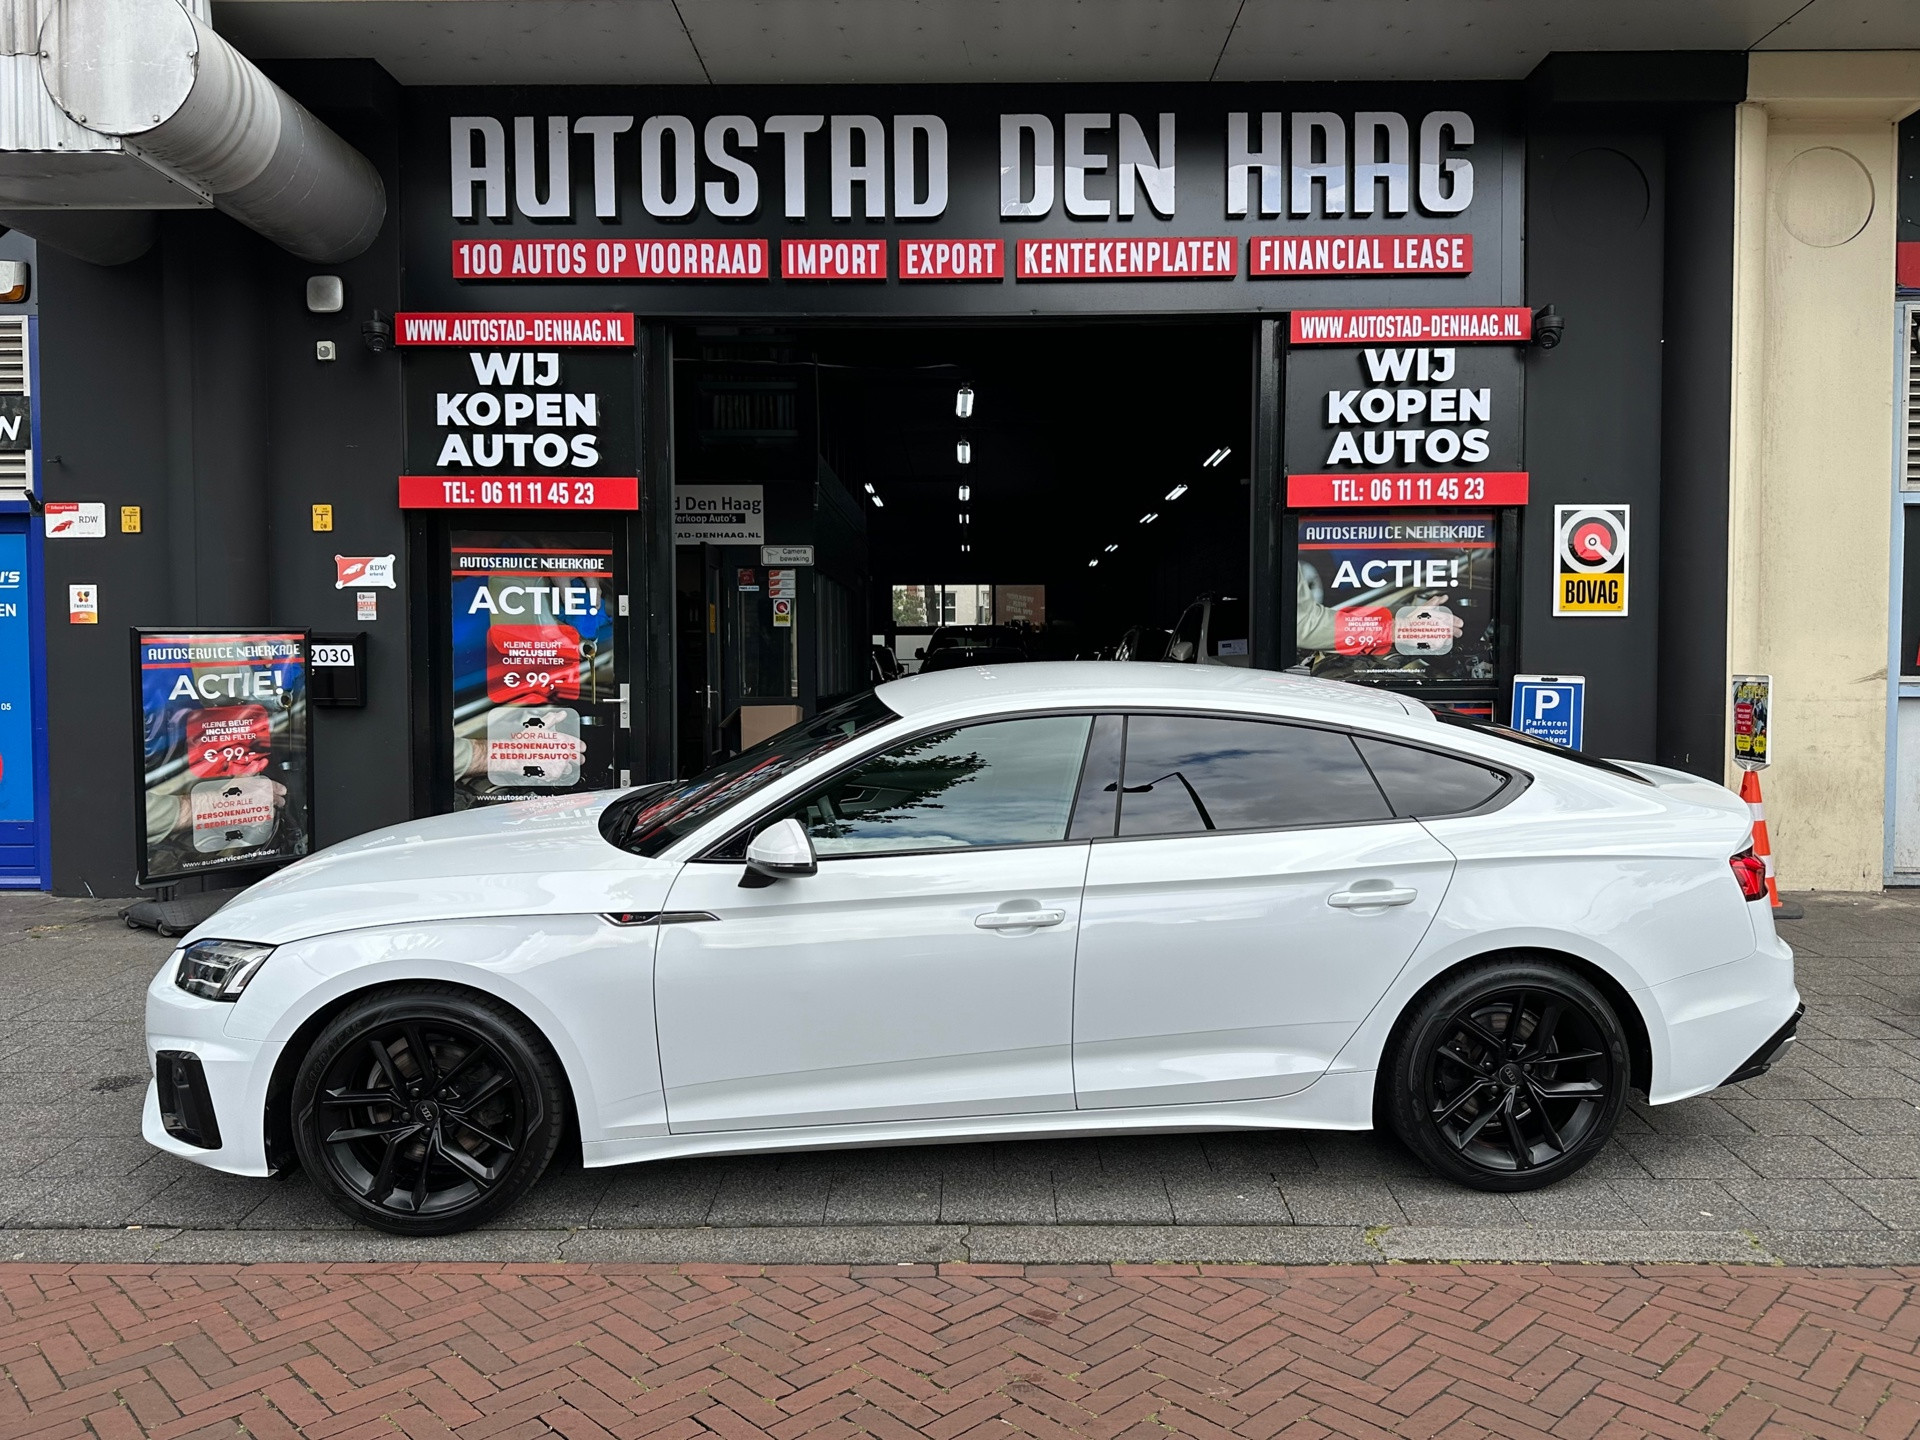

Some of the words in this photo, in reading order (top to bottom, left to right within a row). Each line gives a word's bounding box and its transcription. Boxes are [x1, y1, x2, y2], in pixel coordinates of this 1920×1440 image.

[450, 115, 949, 218] AUTOSTAD
[1000, 113, 1175, 216] DEN
[1227, 111, 1474, 213] HAAG
[460, 244, 502, 275] 100
[512, 244, 587, 275] AUTOS
[597, 244, 627, 275] OP
[637, 243, 762, 274] VOORRAAD
[788, 243, 881, 275] IMPORT
[907, 243, 996, 274] EXPORT
[1024, 240, 1231, 274] KENTEKENPLATEN
[1260, 239, 1384, 272] FINANCIAL
[1394, 238, 1464, 269] LEASE
[405, 319, 625, 343] WWW.AUTOSTAD-DENHAAG.NL
[1300, 315, 1521, 339] WWW.AUTOSTAD-DENHAAG.NL
[470, 352, 559, 386] WIJ
[1365, 348, 1456, 382] WIJ
[436, 392, 597, 427] KOPEN
[1328, 388, 1491, 424] KOPEN
[436, 434, 599, 467] AUTOS
[1327, 429, 1490, 465] AUTOS
[443, 482, 475, 504] TEL:
[481, 482, 503, 504] 06
[508, 482, 524, 504] 11
[527, 482, 542, 504] 11
[547, 482, 569, 504] 45
[574, 482, 595, 504] 23
[1332, 480, 1364, 502] TEL:
[1370, 479, 1391, 501] 06
[1397, 479, 1412, 501] 11
[1417, 479, 1431, 501] 11
[1437, 479, 1459, 500] 45
[1464, 478, 1484, 500] 23
[685, 497, 716, 511] Den
[722, 497, 762, 514] Haag
[709, 514, 737, 522] Auto's
[1306, 526, 1402, 540] AUTOSERVICE
[1406, 525, 1485, 539] NEHERKADE
[460, 557, 538, 569] AUTOSERVICE
[541, 558, 605, 570] NEHERKADE
[1331, 559, 1459, 588] ACTIE!
[468, 586, 598, 616] ACTIE!
[1564, 579, 1618, 604] BOVAG
[148, 647, 233, 660] AUTOSERVICE
[236, 644, 301, 658] NEHERKADE
[503, 641, 532, 649] KLEINE
[534, 641, 563, 649] BEURT
[508, 649, 558, 657] INCLUSIEF
[502, 657, 522, 665] OLIE
[524, 657, 535, 665] EN
[168, 670, 284, 700] ACTIE!
[503, 672, 520, 688] €
[525, 672, 564, 690] 99,-
[1535, 689, 1560, 720] P
[206, 726, 251, 735] INCLUSIEF
[228, 719, 254, 727] BEURT
[1525, 719, 1568, 727] Parkeren
[200, 735, 219, 743] OLIE
[232, 733, 256, 741] FILTER
[492, 742, 576, 750] PERSONENAUTO'S
[510, 732, 535, 740] VOOR
[203, 749, 218, 762] €
[196, 805, 270, 821] PERSONENAUTO'S
[237, 798, 253, 806] ALLE
